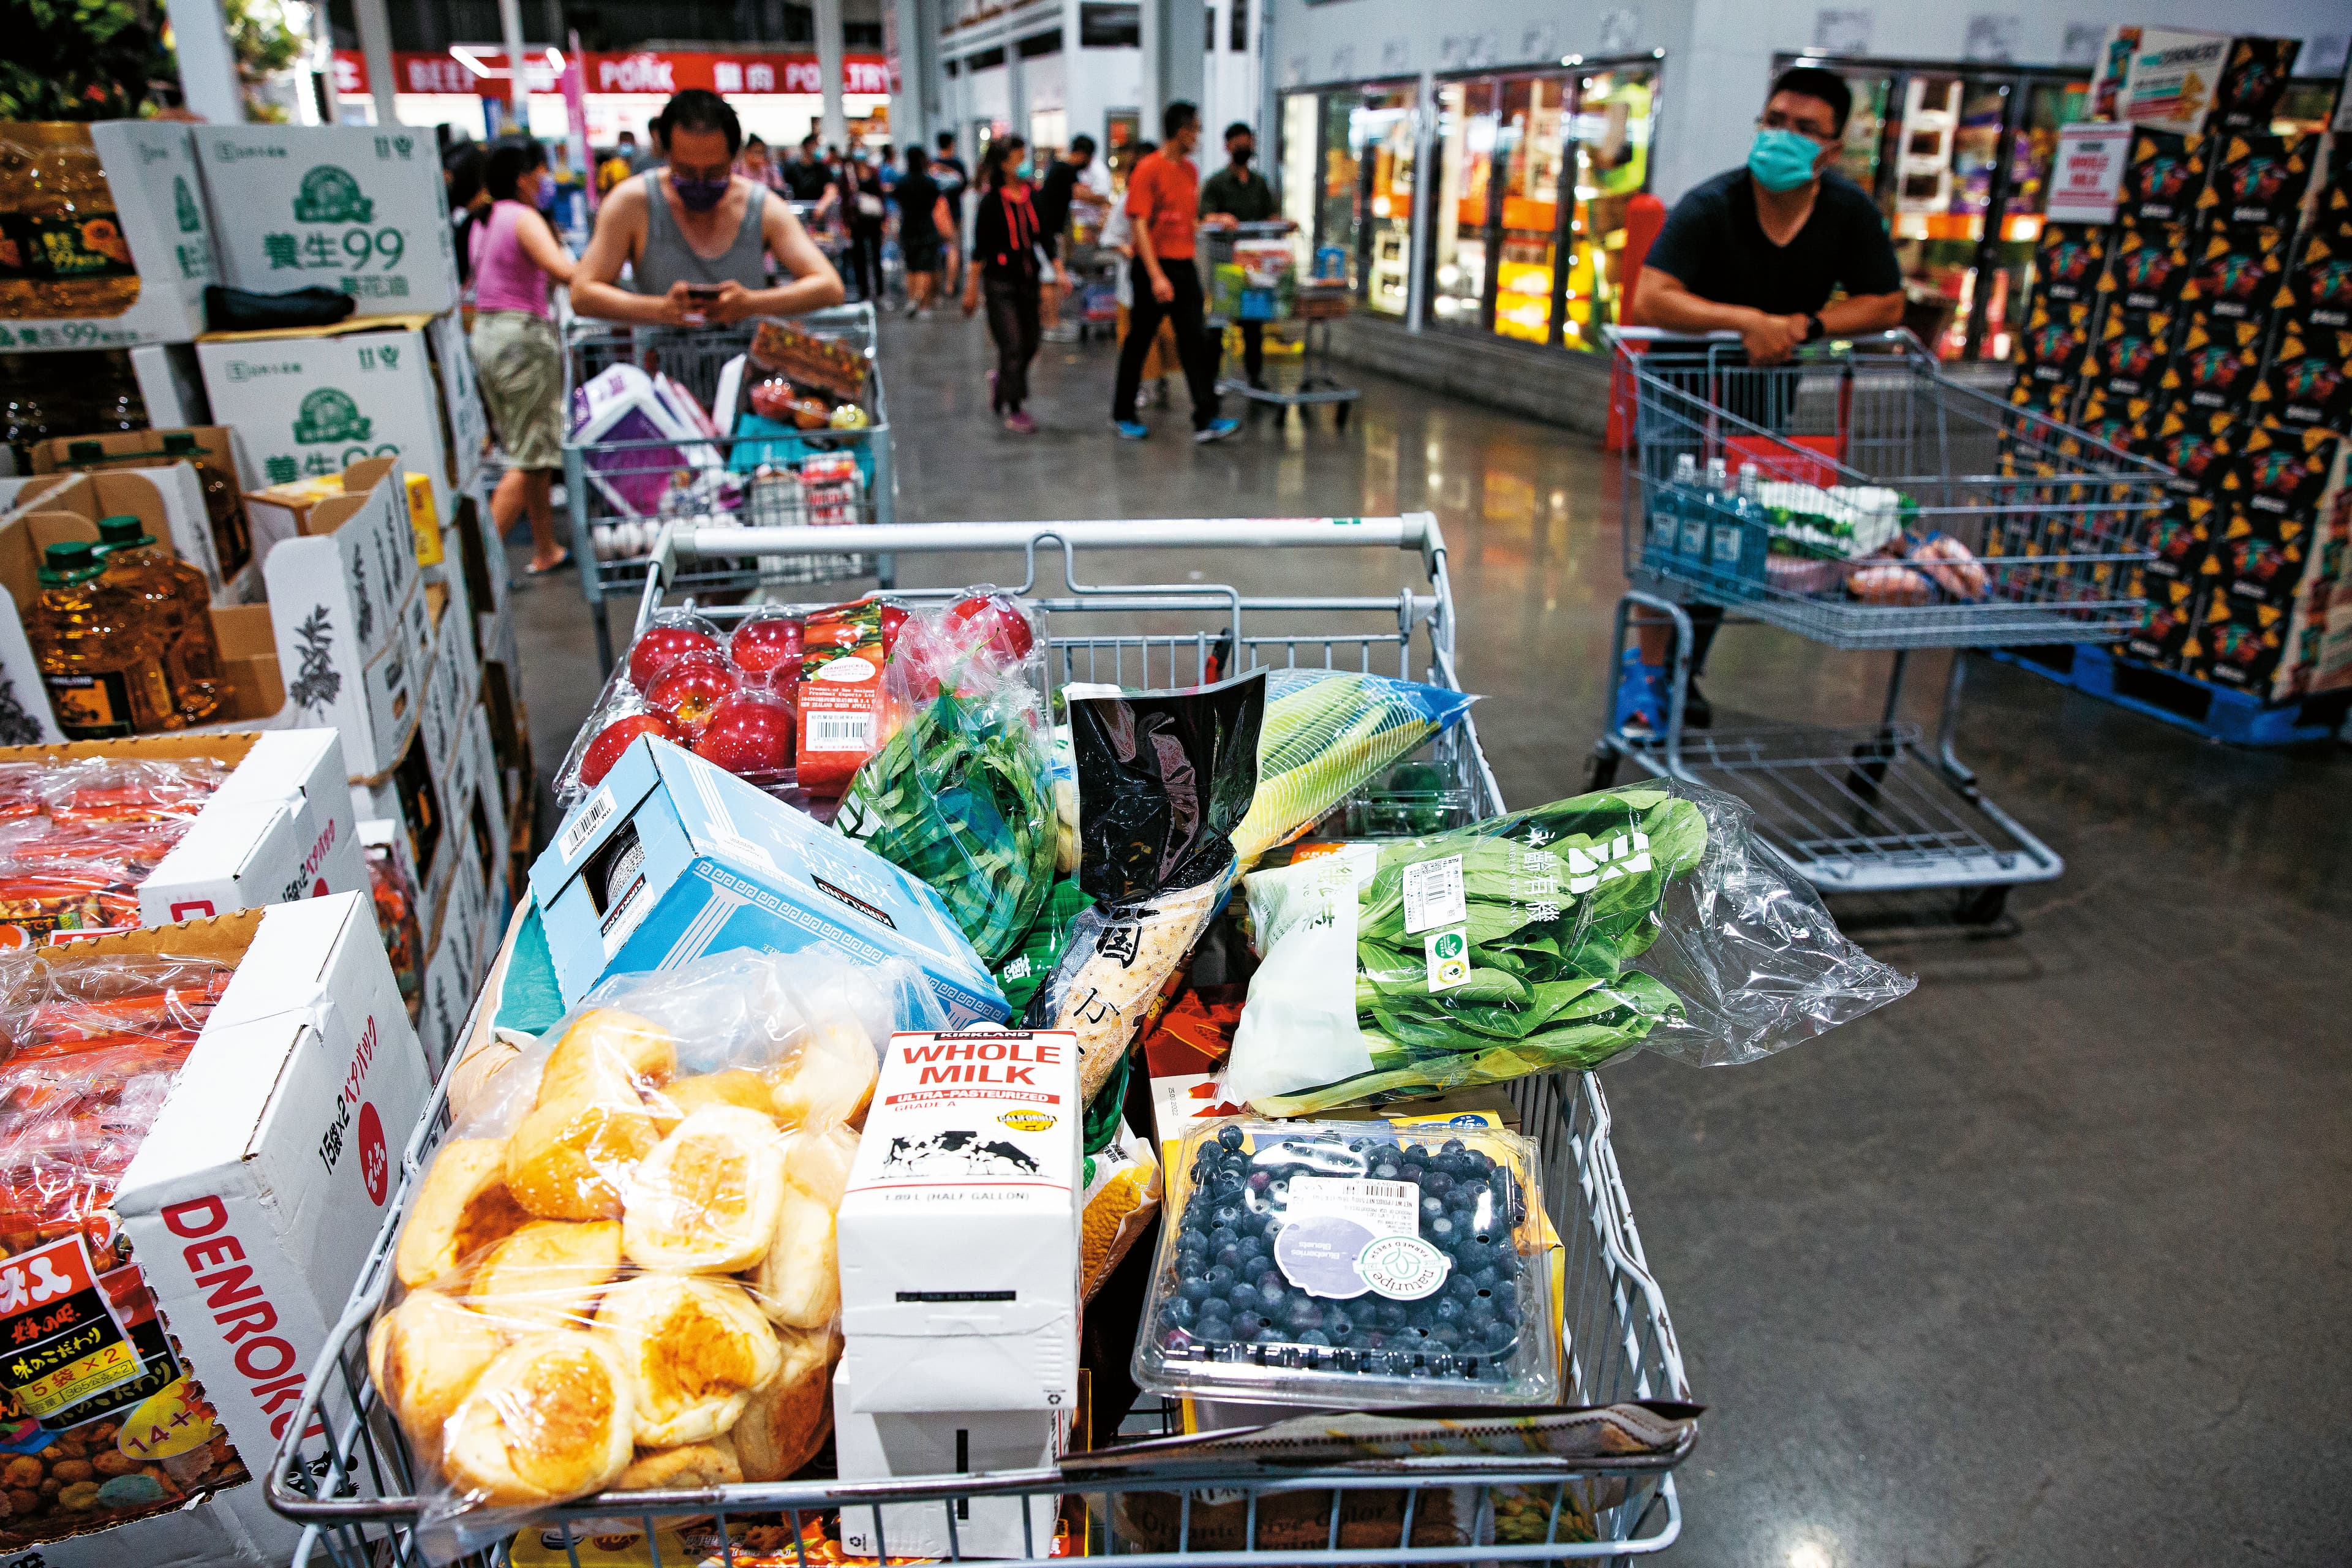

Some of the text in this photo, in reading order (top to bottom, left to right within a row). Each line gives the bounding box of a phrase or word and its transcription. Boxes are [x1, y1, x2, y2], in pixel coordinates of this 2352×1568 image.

[769, 827, 902, 908] YOGURT
[799, 855, 883, 907] GREEK
[1507, 837, 1520, 926] YONGLIN ORGANIC
[1521, 827, 1560, 923] 永齡有機
[603, 881, 644, 935] KIRKLAND
[818, 882, 892, 927] KIRKLAND
[903, 1044, 1061, 1064] WHOLE
[919, 1065, 1036, 1085] MILK
[894, 1102, 939, 1112] GRADE
[897, 1089, 1049, 1102] ULTRA-PASTEURIZED
[927, 1193, 964, 1201] (HALF
[971, 1192, 1030, 1201] GALLON)
[1370, 1241, 1428, 1258] FARMED FRESH
[1372, 1270, 1434, 1291] naturipe
[12, 1326, 101, 1380] 味のこだわり
